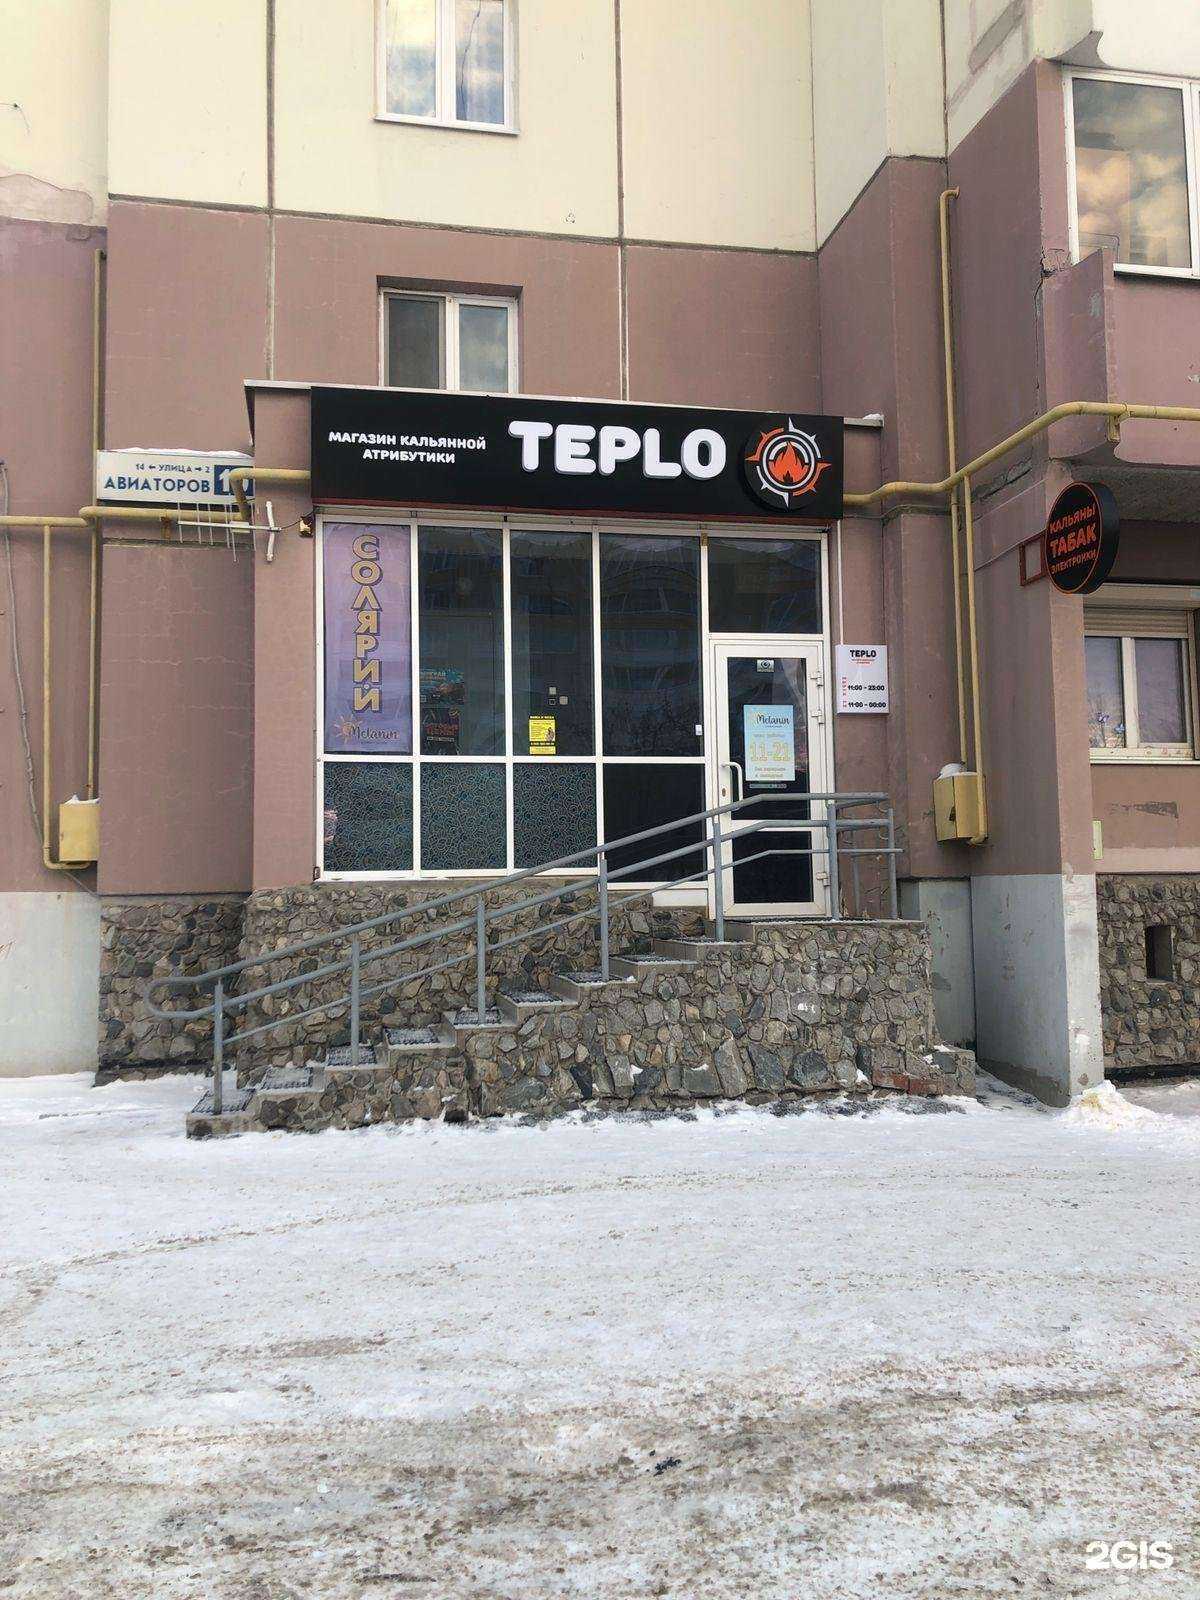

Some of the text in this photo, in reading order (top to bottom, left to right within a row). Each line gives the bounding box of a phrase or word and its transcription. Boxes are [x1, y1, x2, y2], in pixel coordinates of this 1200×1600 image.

[328, 431, 486, 450] МАГАЗИН КАЛЬЯННОЙ
[508, 420, 727, 480] TEPLO
[362, 448, 456, 464] АТРИБУТИКИ
[158, 464, 193, 474] УЛИЦА
[204, 466, 211, 474] 2
[104, 475, 211, 493] АВИАТОРОВ
[1049, 502, 1096, 534] КАЛЬЯНЫ
[1049, 522, 1097, 559] ТАБАК
[351, 534, 384, 714] СОЛЯРИЙ
[849, 649, 877, 658] TEPLO
